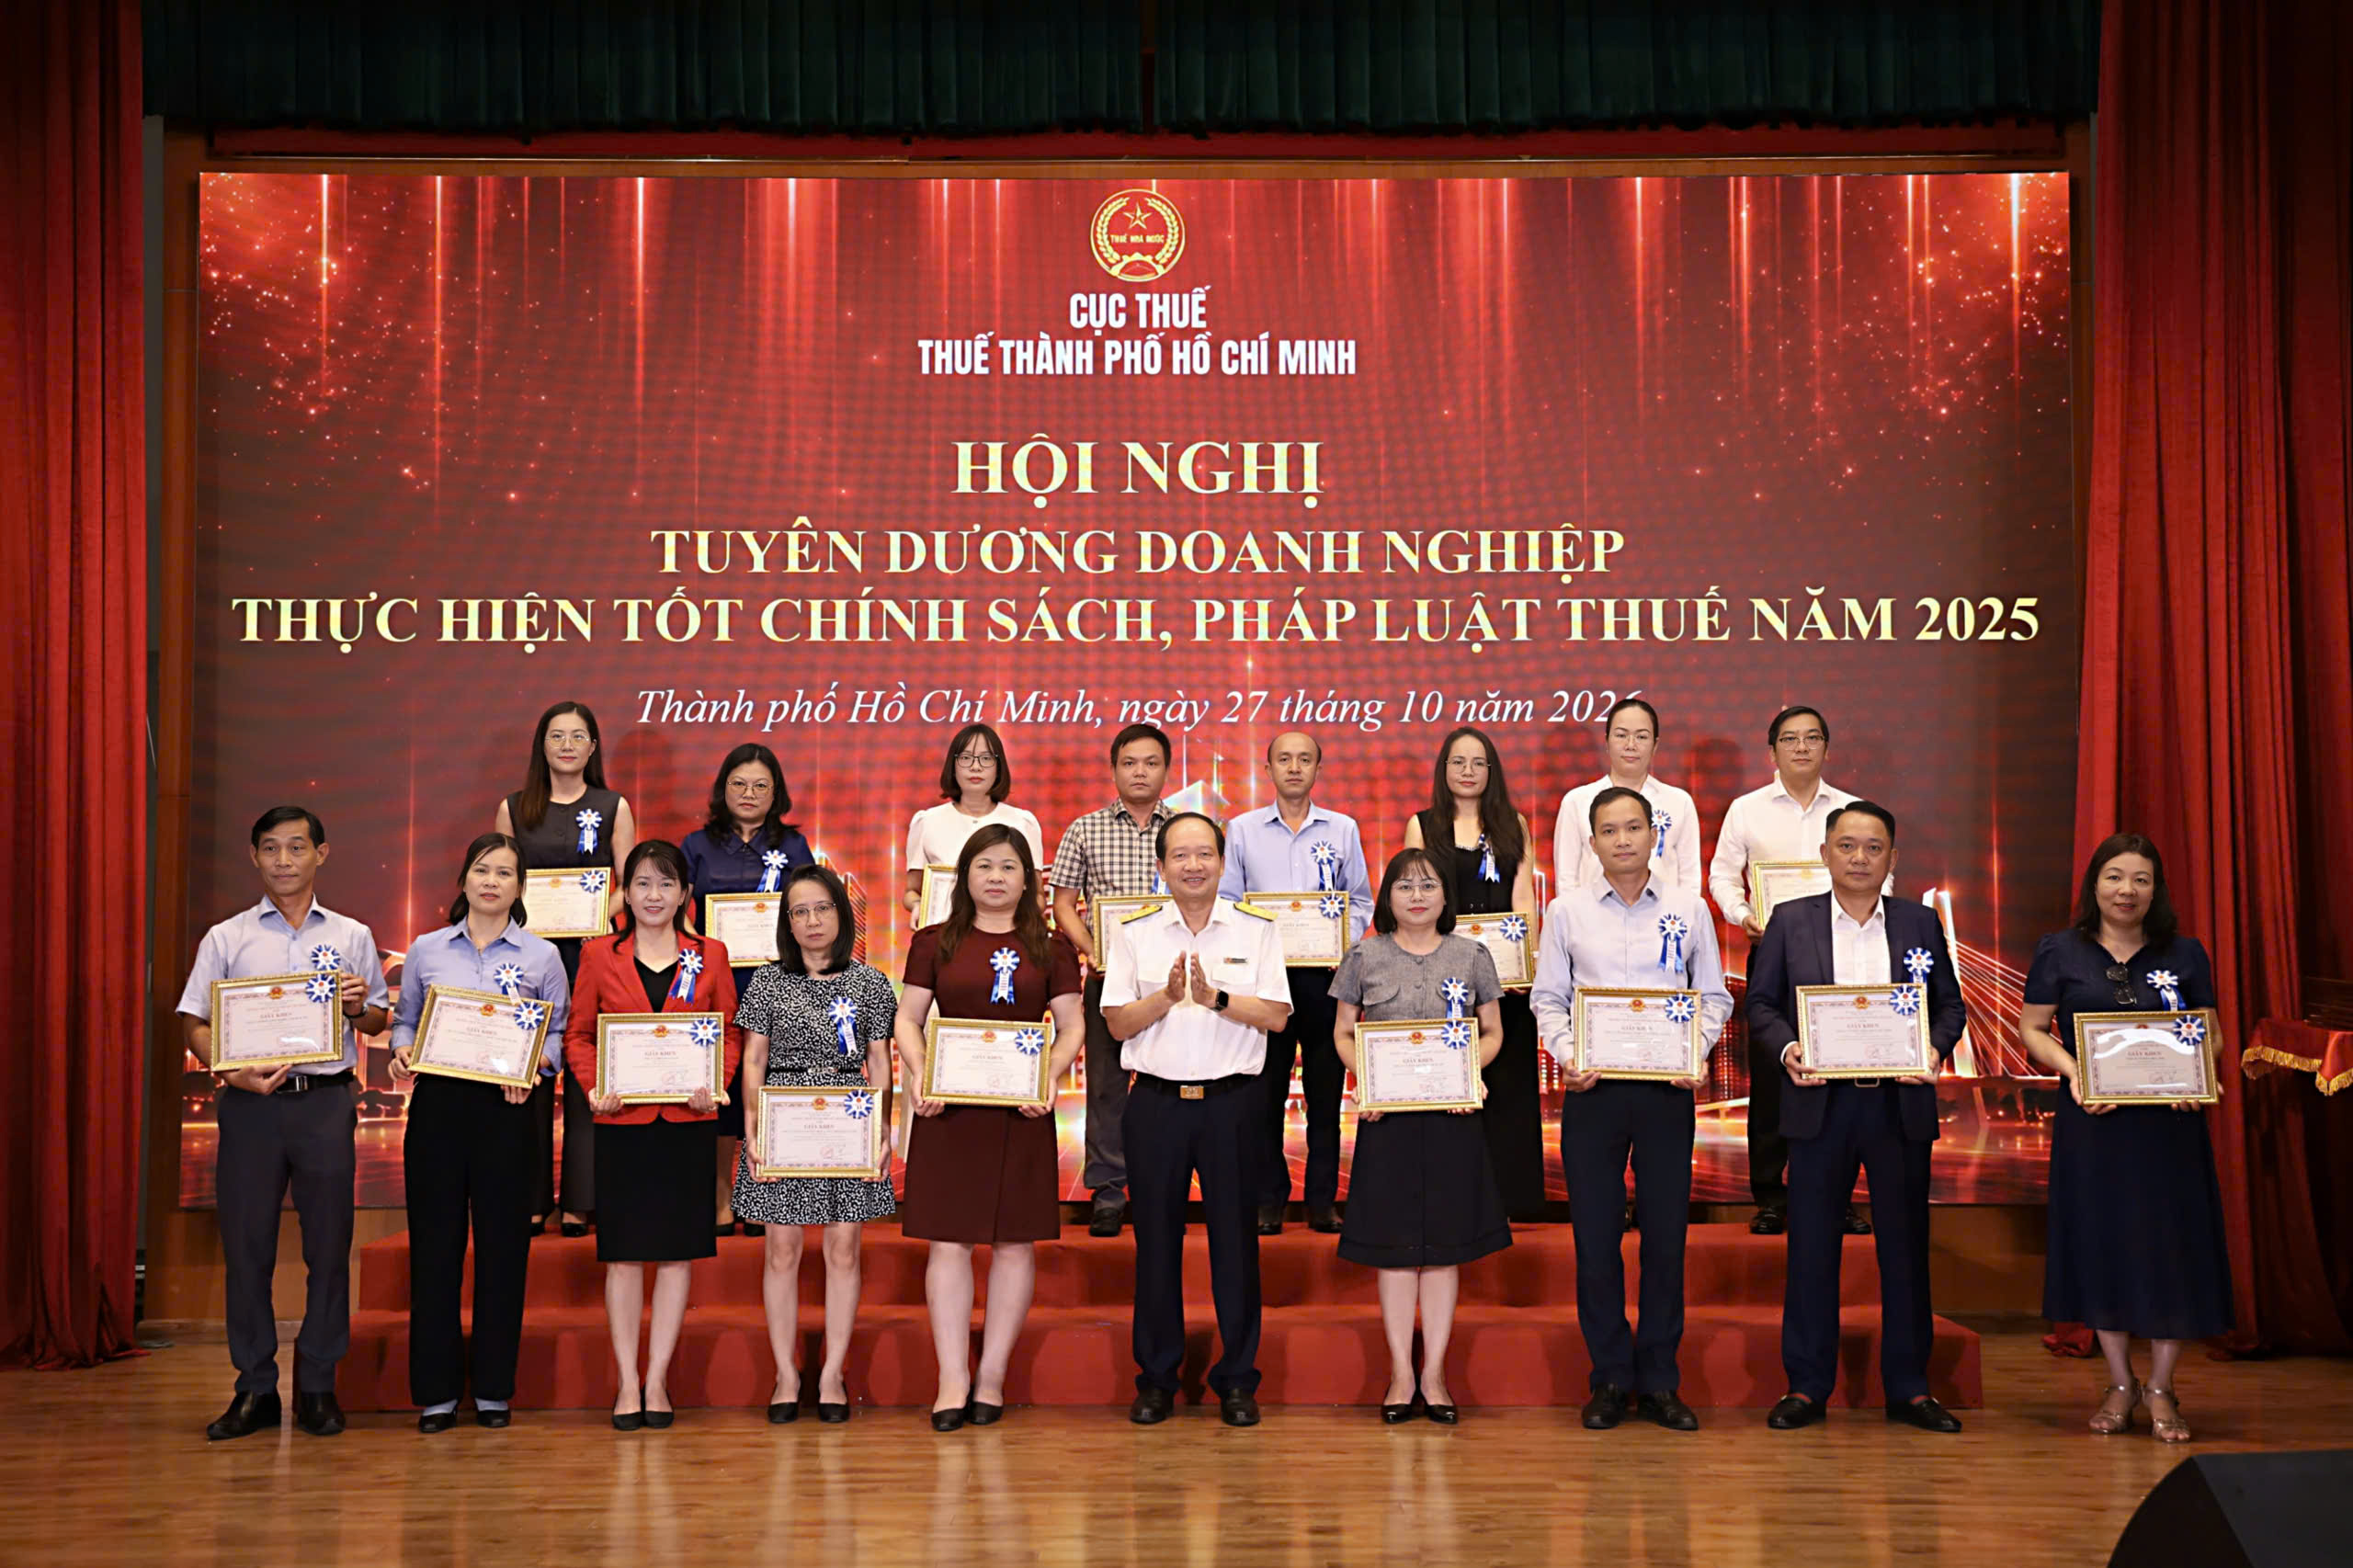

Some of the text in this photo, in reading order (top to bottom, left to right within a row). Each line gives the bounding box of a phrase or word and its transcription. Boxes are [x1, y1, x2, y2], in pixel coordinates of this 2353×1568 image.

[1070, 286, 1211, 335] CỤC THUẾ
[918, 330, 1356, 375] THUẾ THÀNH PHỐ HỒ CHÍ MINH
[952, 434, 1324, 508] HỘI NGHỊ
[651, 517, 1625, 585] TUYÊN DƯƠNG DOANH NGHIỆP
[233, 586, 2039, 653] THỰC HIỆN TỐT CHÍNH SÁCH, PHÁP LUẬT THUẾ NĂM 2025
[638, 689, 753, 723] Thành
[762, 682, 838, 733] phố
[847, 682, 906, 723] Hồ
[920, 689, 987, 723] Chí
[996, 689, 1101, 729] Minh,
[1119, 690, 1210, 733] ngày
[1221, 690, 1269, 723] 27
[1279, 688, 1385, 733] tháng
[1400, 690, 1442, 723] 10
[1456, 692, 1533, 723] năm
